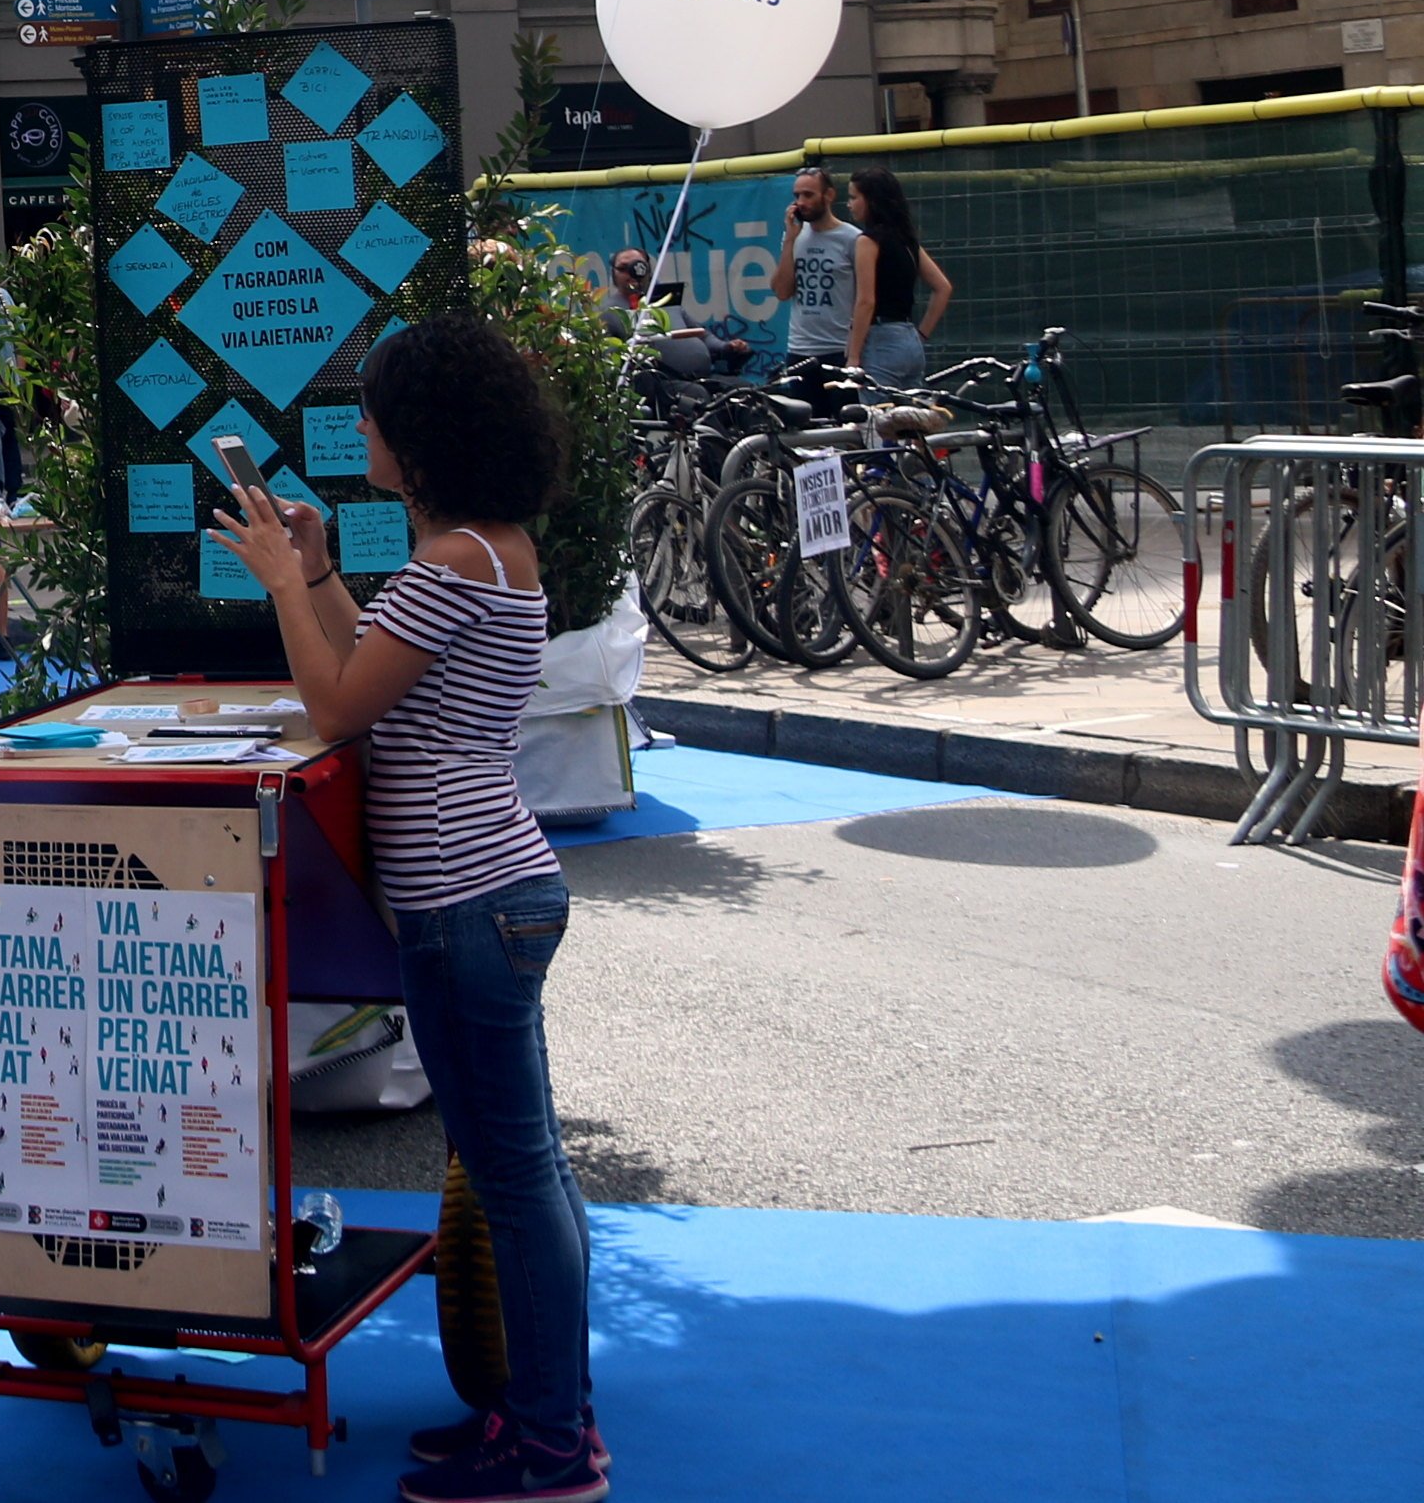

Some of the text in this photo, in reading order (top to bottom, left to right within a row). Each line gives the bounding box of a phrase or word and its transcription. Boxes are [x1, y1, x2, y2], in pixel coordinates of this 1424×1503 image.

[363, 129, 440, 143] TRANQUILA
[8, 195, 56, 205] CAFFE
[172, 197, 222, 213] VEHICLES
[254, 240, 289, 259] COM
[795, 258, 835, 274] ROC
[222, 267, 325, 290] T'AGRADARIA
[233, 296, 319, 320] QUE FOS LA
[222, 325, 334, 349] VIA LAIETANA?
[123, 373, 197, 388] PEATONAL
[799, 468, 837, 494] INSISTA
[805, 510, 843, 543] AMOR
[96, 901, 141, 936] VIA
[97, 939, 233, 983] LAIETANA,
[97, 978, 248, 1019] UN CARRER
[98, 1017, 190, 1056] PER AL
[96, 1053, 192, 1096] VEÏNAT
